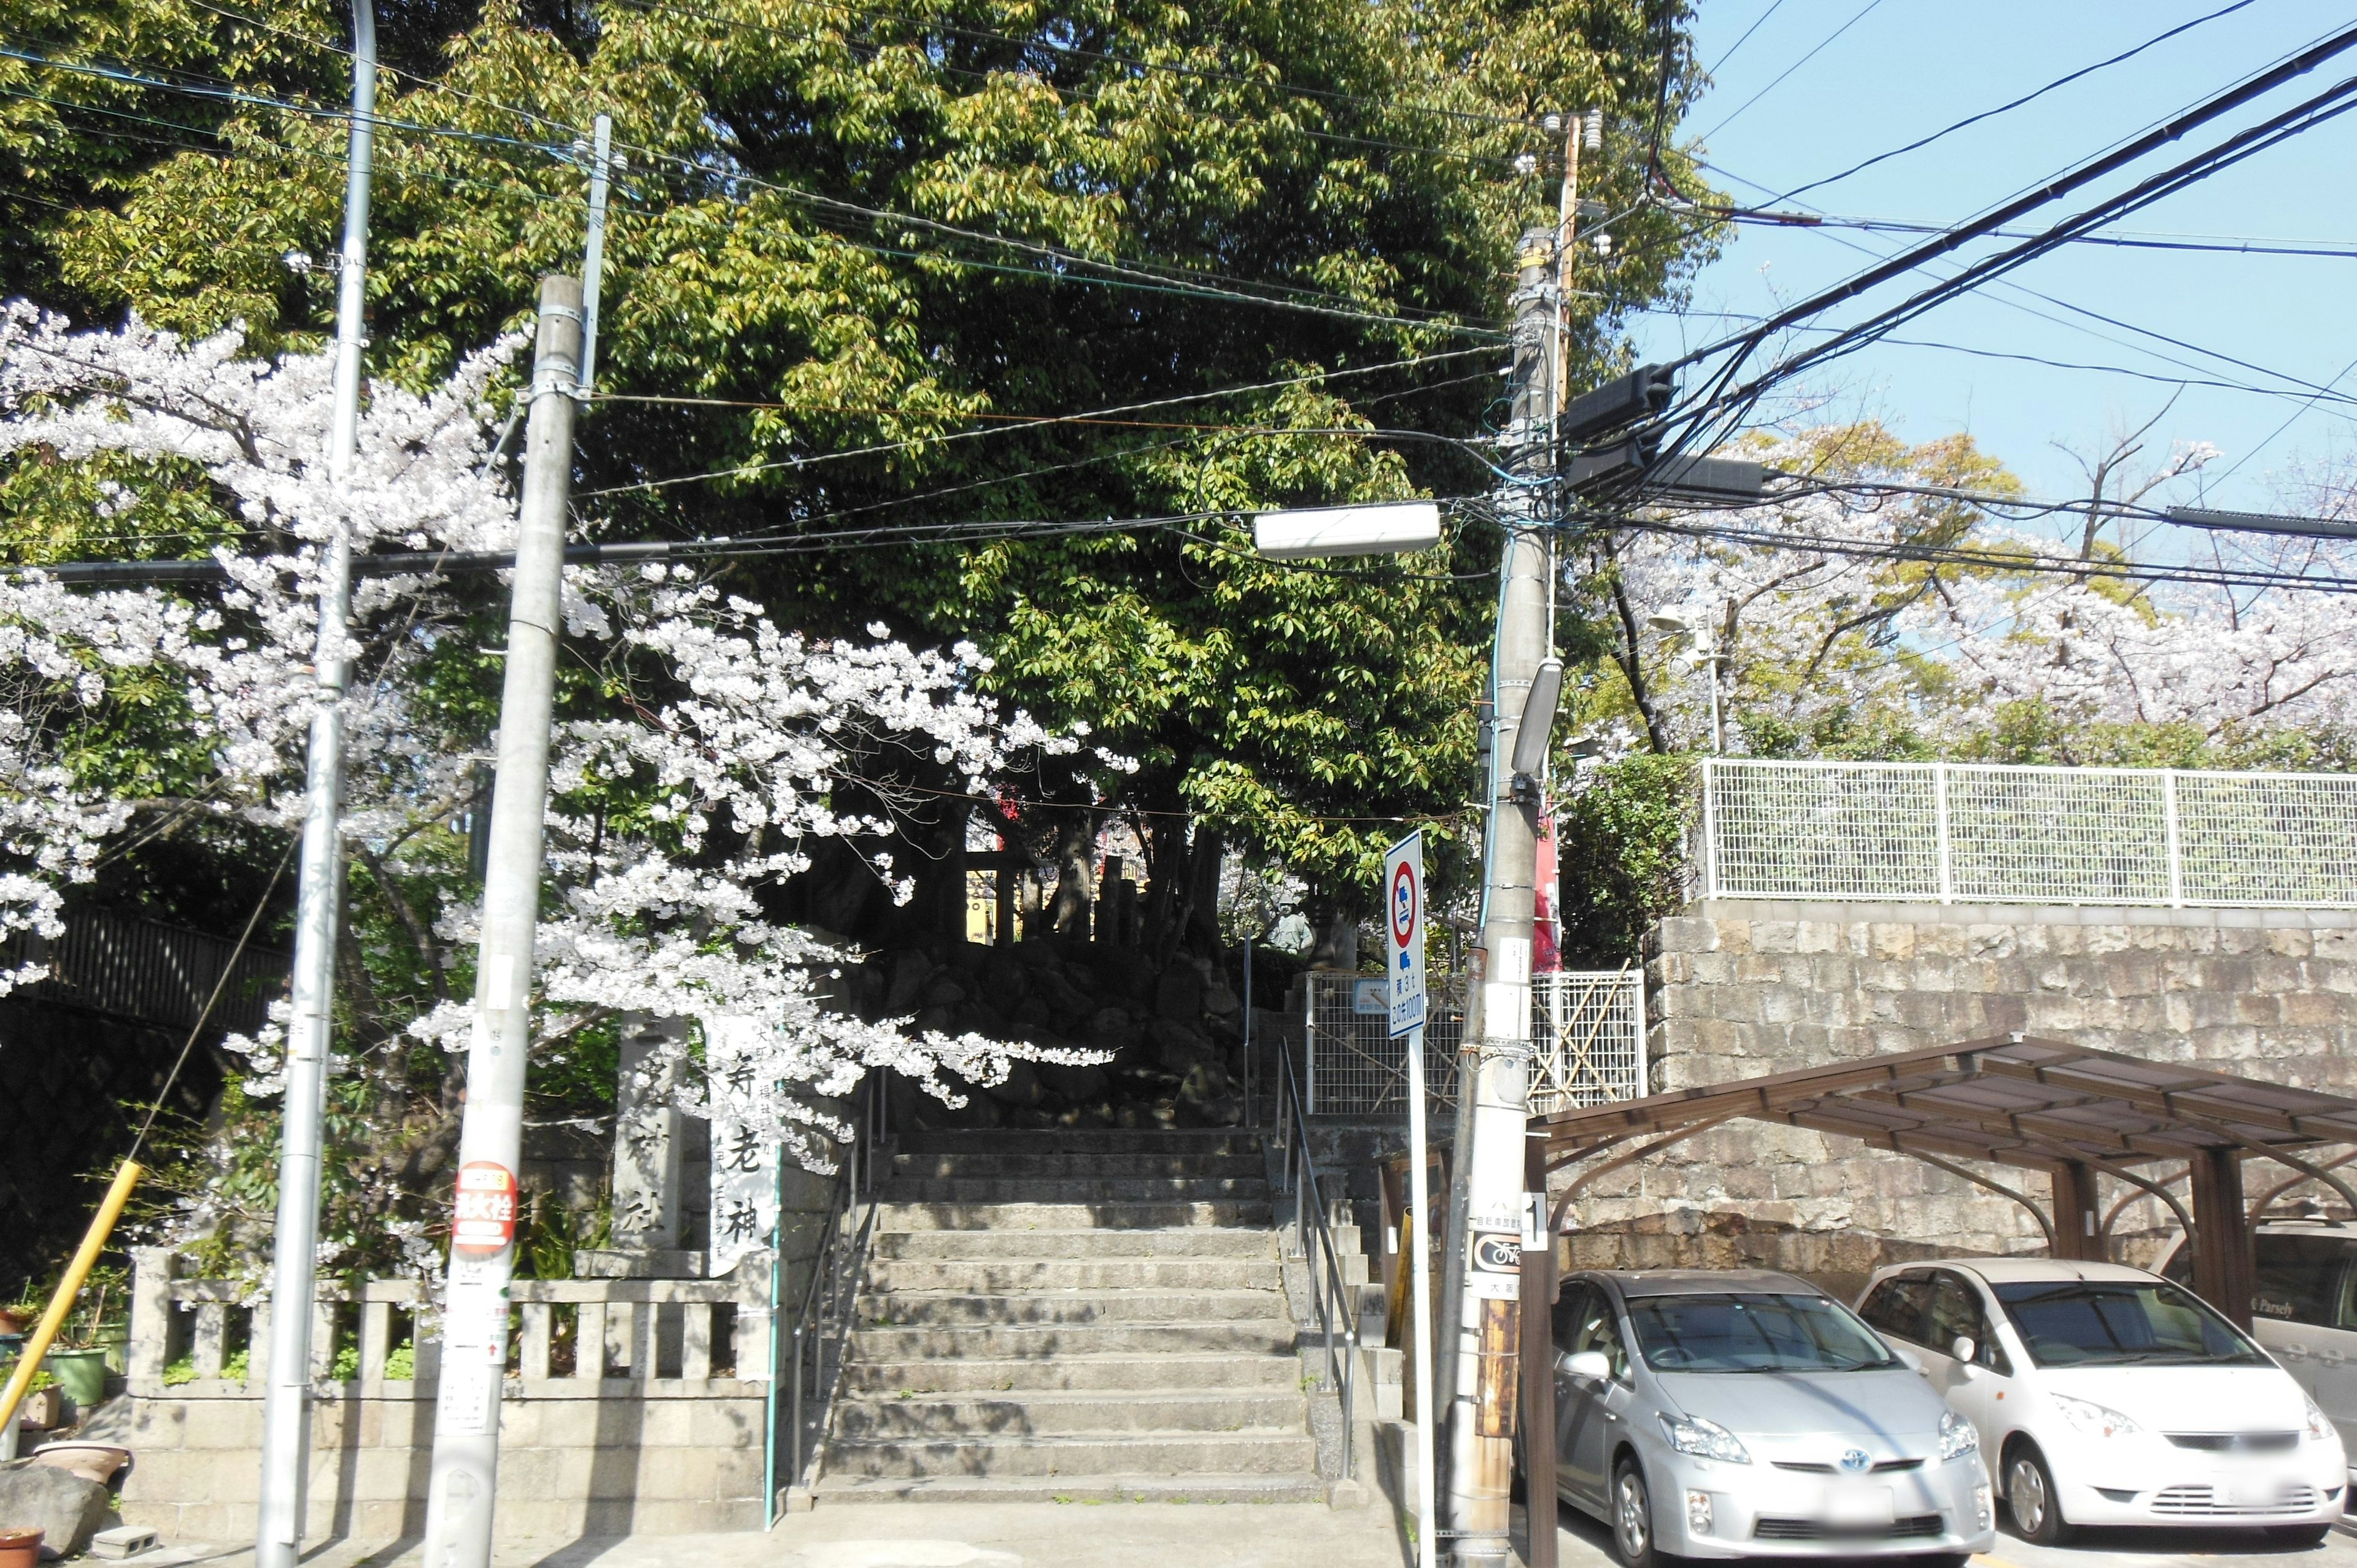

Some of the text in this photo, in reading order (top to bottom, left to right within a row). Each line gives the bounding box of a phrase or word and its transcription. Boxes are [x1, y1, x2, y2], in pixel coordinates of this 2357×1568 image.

[1393, 993, 1422, 1025] この先100m
[725, 1050, 761, 1245] 寿老神
[454, 1192, 513, 1221] 消火栓
[1526, 1201, 1538, 1243] 1
[1490, 1284, 1520, 1294] 大阪
